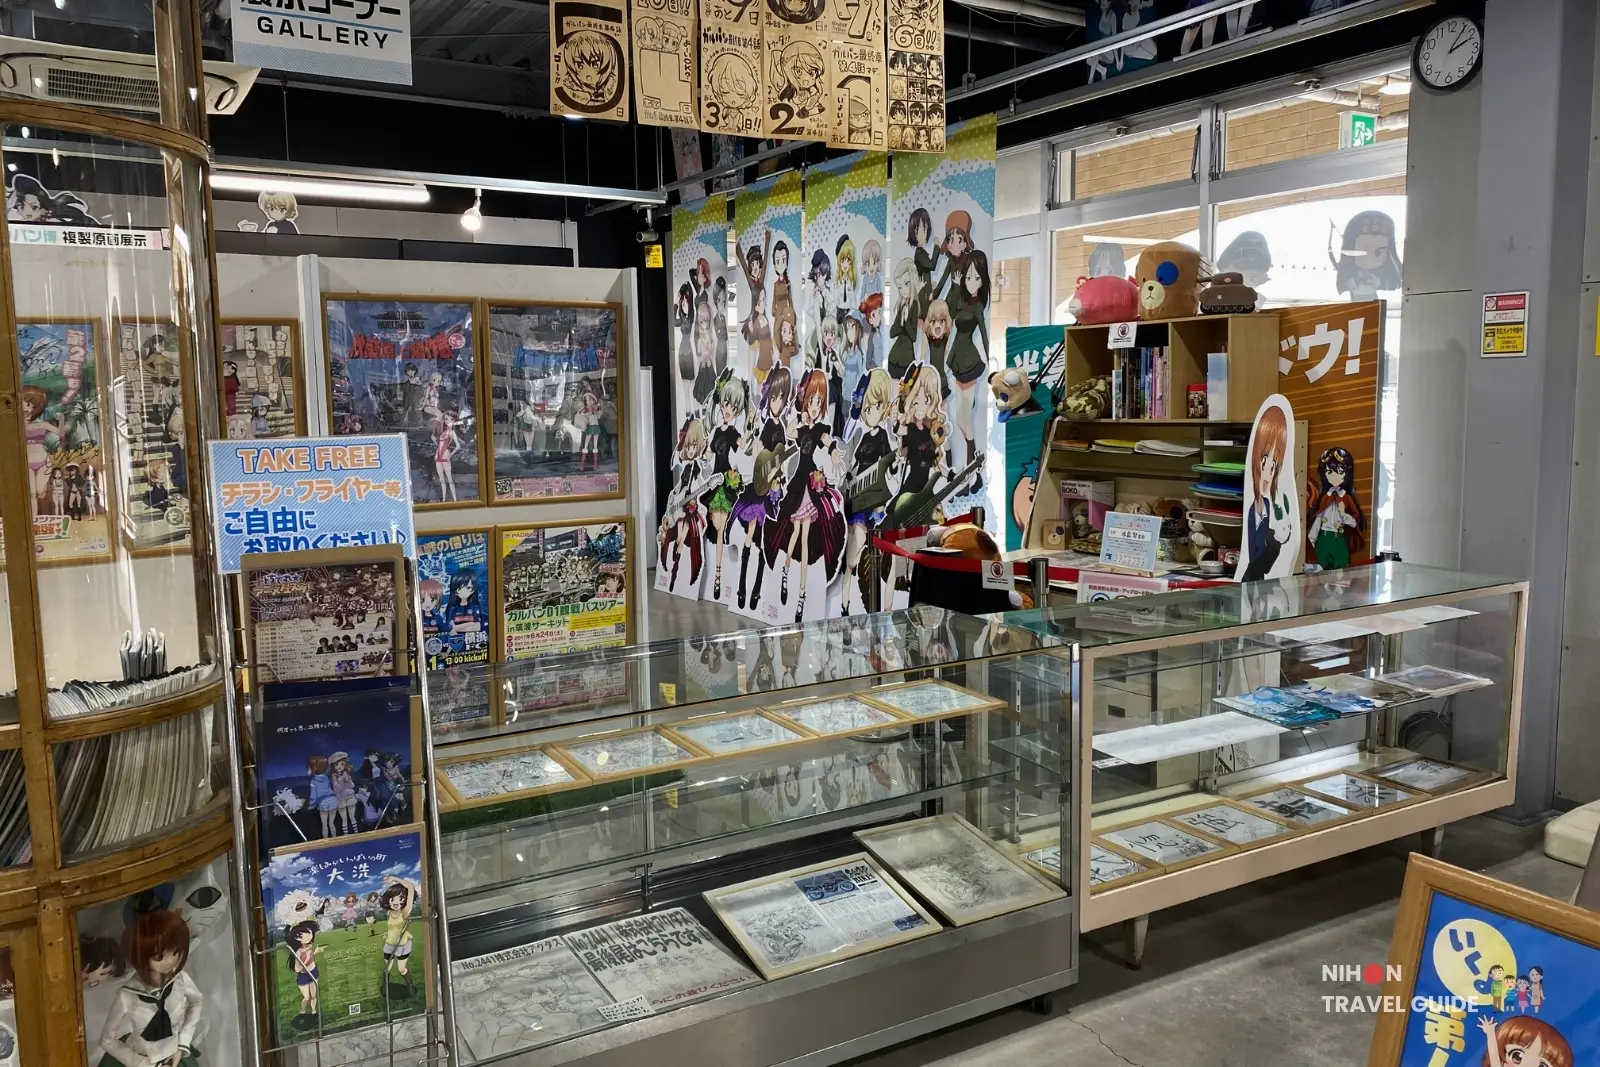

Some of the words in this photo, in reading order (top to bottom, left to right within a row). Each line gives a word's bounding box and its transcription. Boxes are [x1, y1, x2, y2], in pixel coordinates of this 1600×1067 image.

[241, 0, 401, 19] コーナー
[257, 16, 388, 48] GALLERY
[1436, 27, 1444, 39] 11
[1447, 20, 1457, 33] 12
[894, 24, 914, 48] 6
[1468, 28, 1476, 40] 2
[1425, 38, 1436, 50] 10
[1472, 42, 1479, 53] 3
[1422, 52, 1430, 63] 9
[1466, 55, 1474, 66] 4
[1425, 64, 1432, 75] 8
[1457, 67, 1465, 78] 5
[1434, 71, 1441, 84] 7
[1444, 72, 1452, 84] 6
[705, 102, 720, 128] 3
[769, 103, 798, 134] 2
[62, 230, 147, 247] 複製原画展示
[237, 447, 311, 474] TAKE
[314, 443, 382, 471] FREE
[221, 476, 401, 506] チラシ・フライヤー等
[1061, 486, 1078, 495] BOKO
[224, 507, 317, 536] ご自由に
[464, 653, 488, 663] kickoff
[326, 863, 370, 885] 大洗
